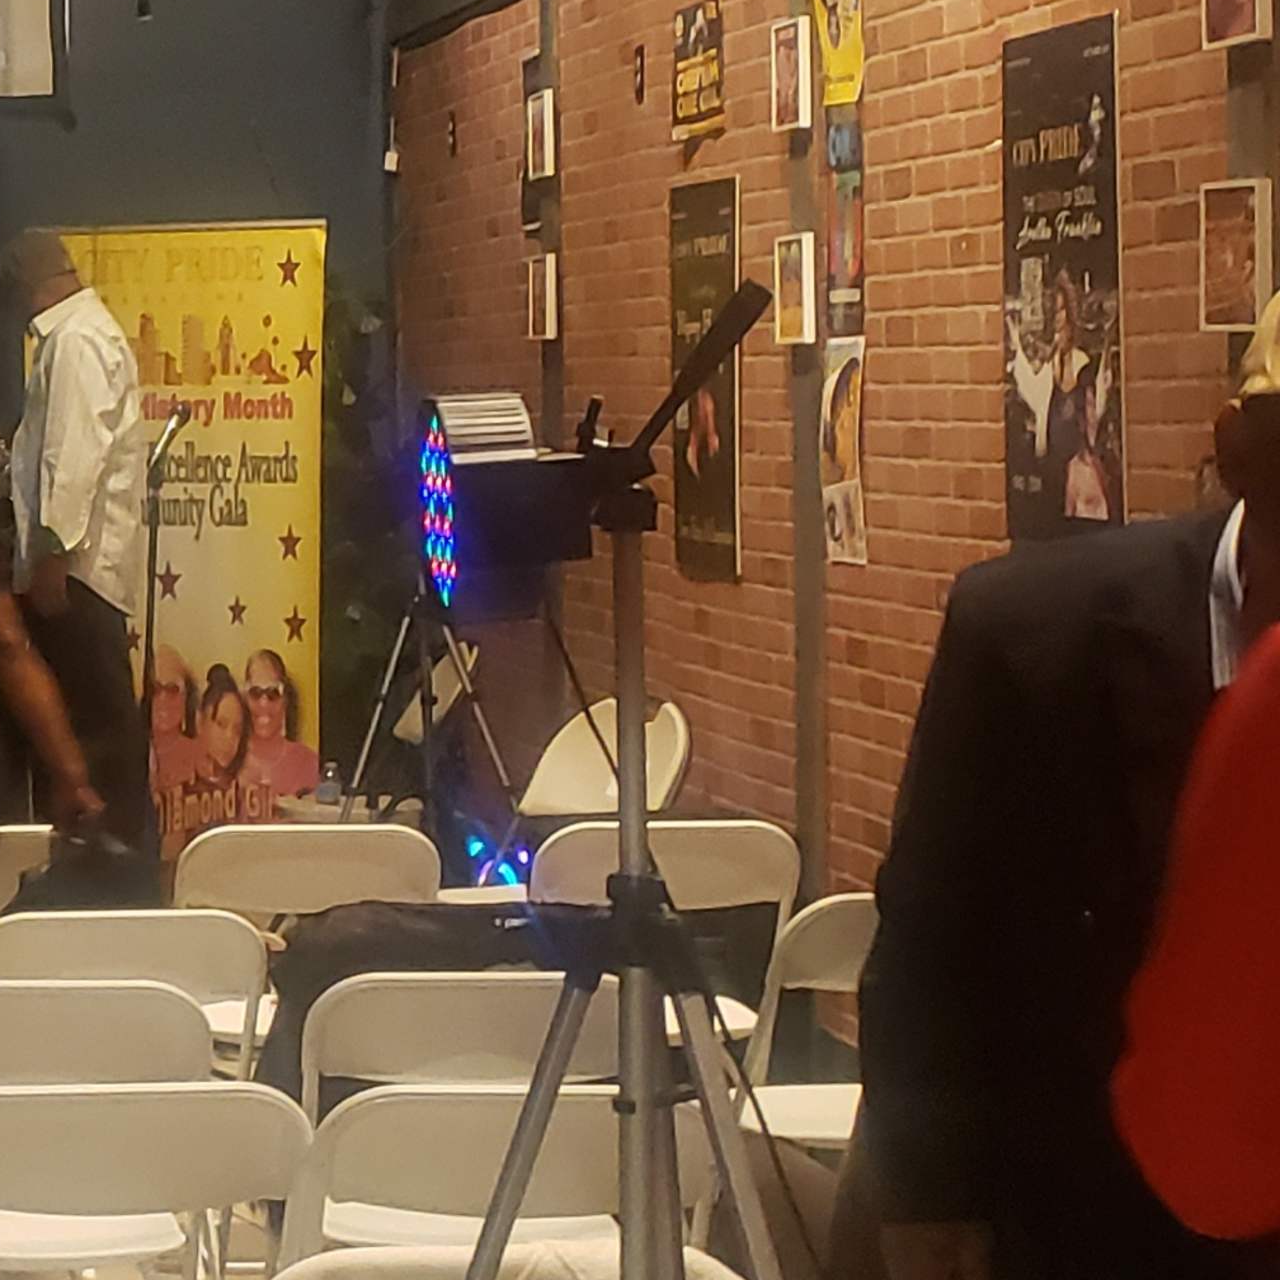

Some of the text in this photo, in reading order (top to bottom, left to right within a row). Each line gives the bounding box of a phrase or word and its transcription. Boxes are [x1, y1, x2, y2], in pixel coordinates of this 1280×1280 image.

[141, 391, 293, 427] Histry Month
[234, 440, 298, 484] Awards
[209, 483, 249, 527] Gala
